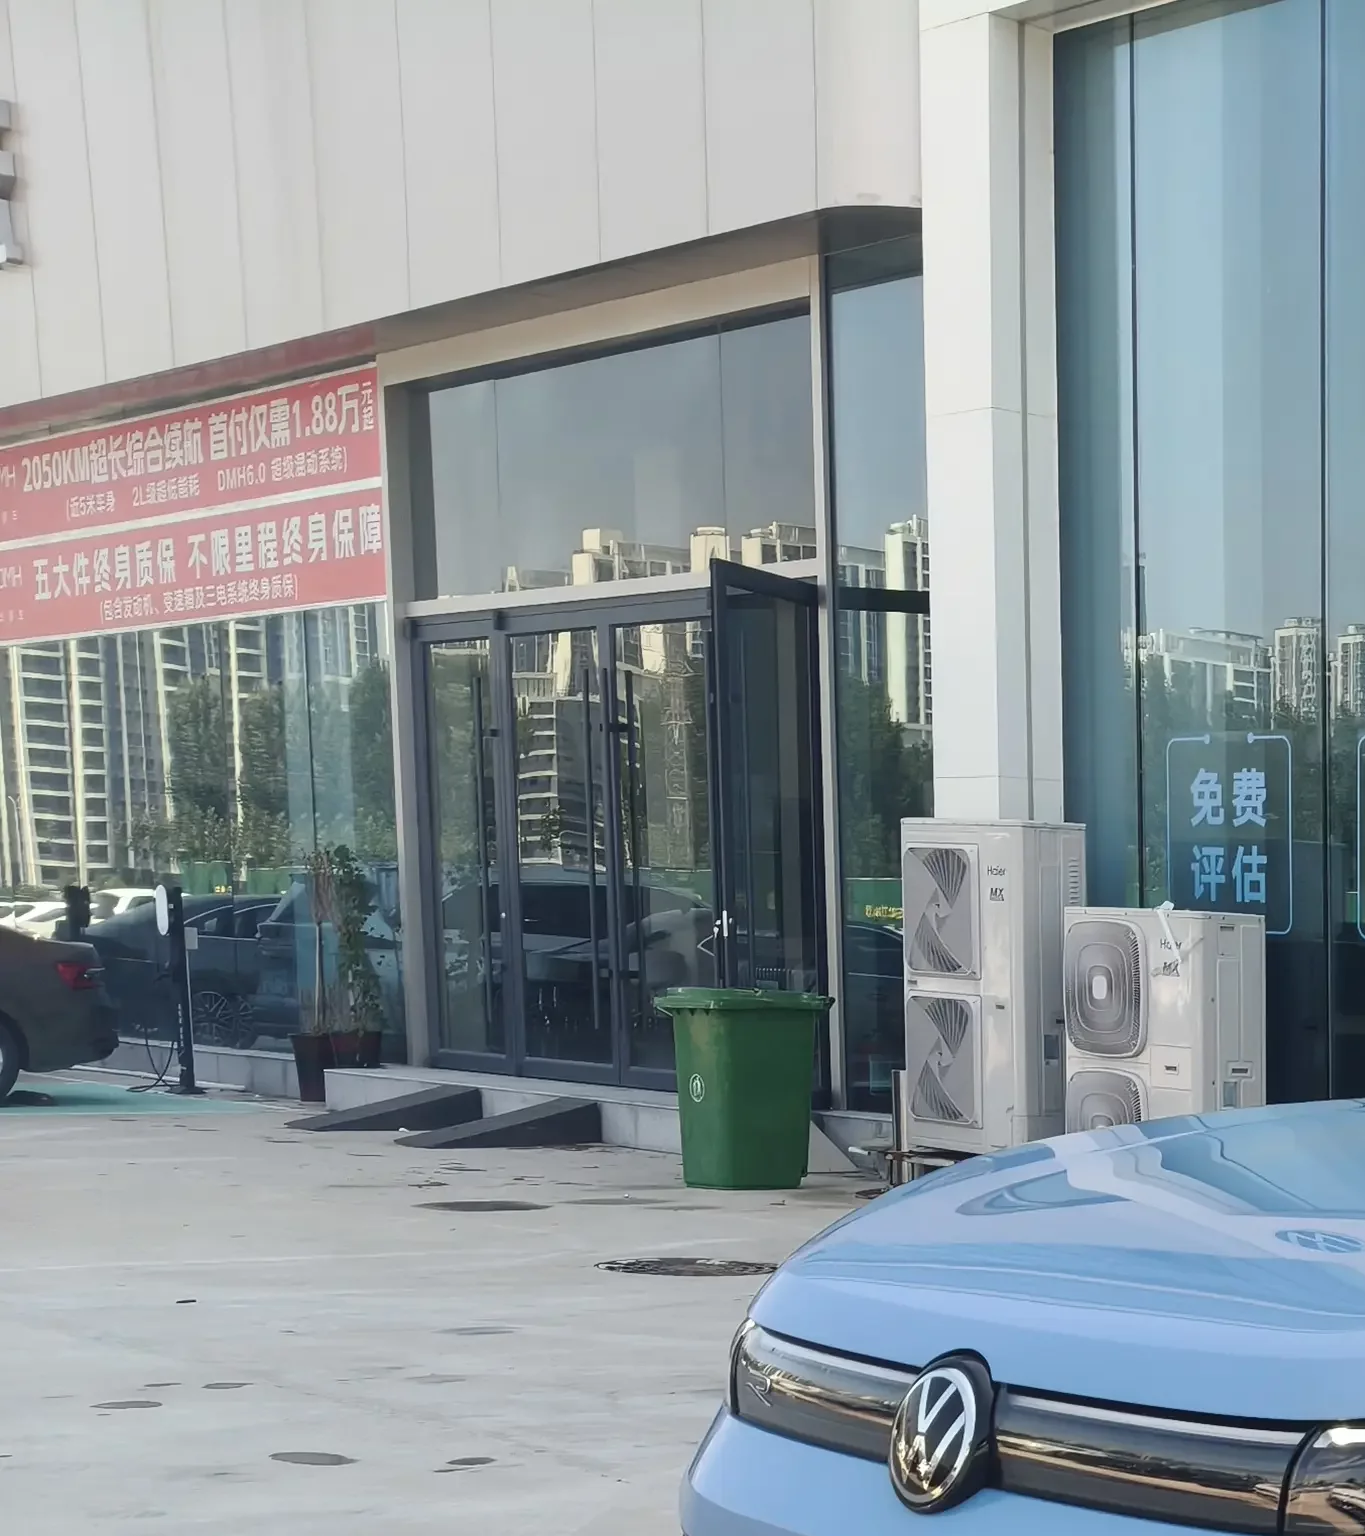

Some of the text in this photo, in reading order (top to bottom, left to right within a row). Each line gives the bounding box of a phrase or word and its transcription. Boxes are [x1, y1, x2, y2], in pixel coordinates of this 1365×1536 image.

[33, 503, 382, 600] 五大件终身质保 不限里程终身保障
[1190, 768, 1267, 828] 免费
[1190, 845, 1268, 905] 评估
